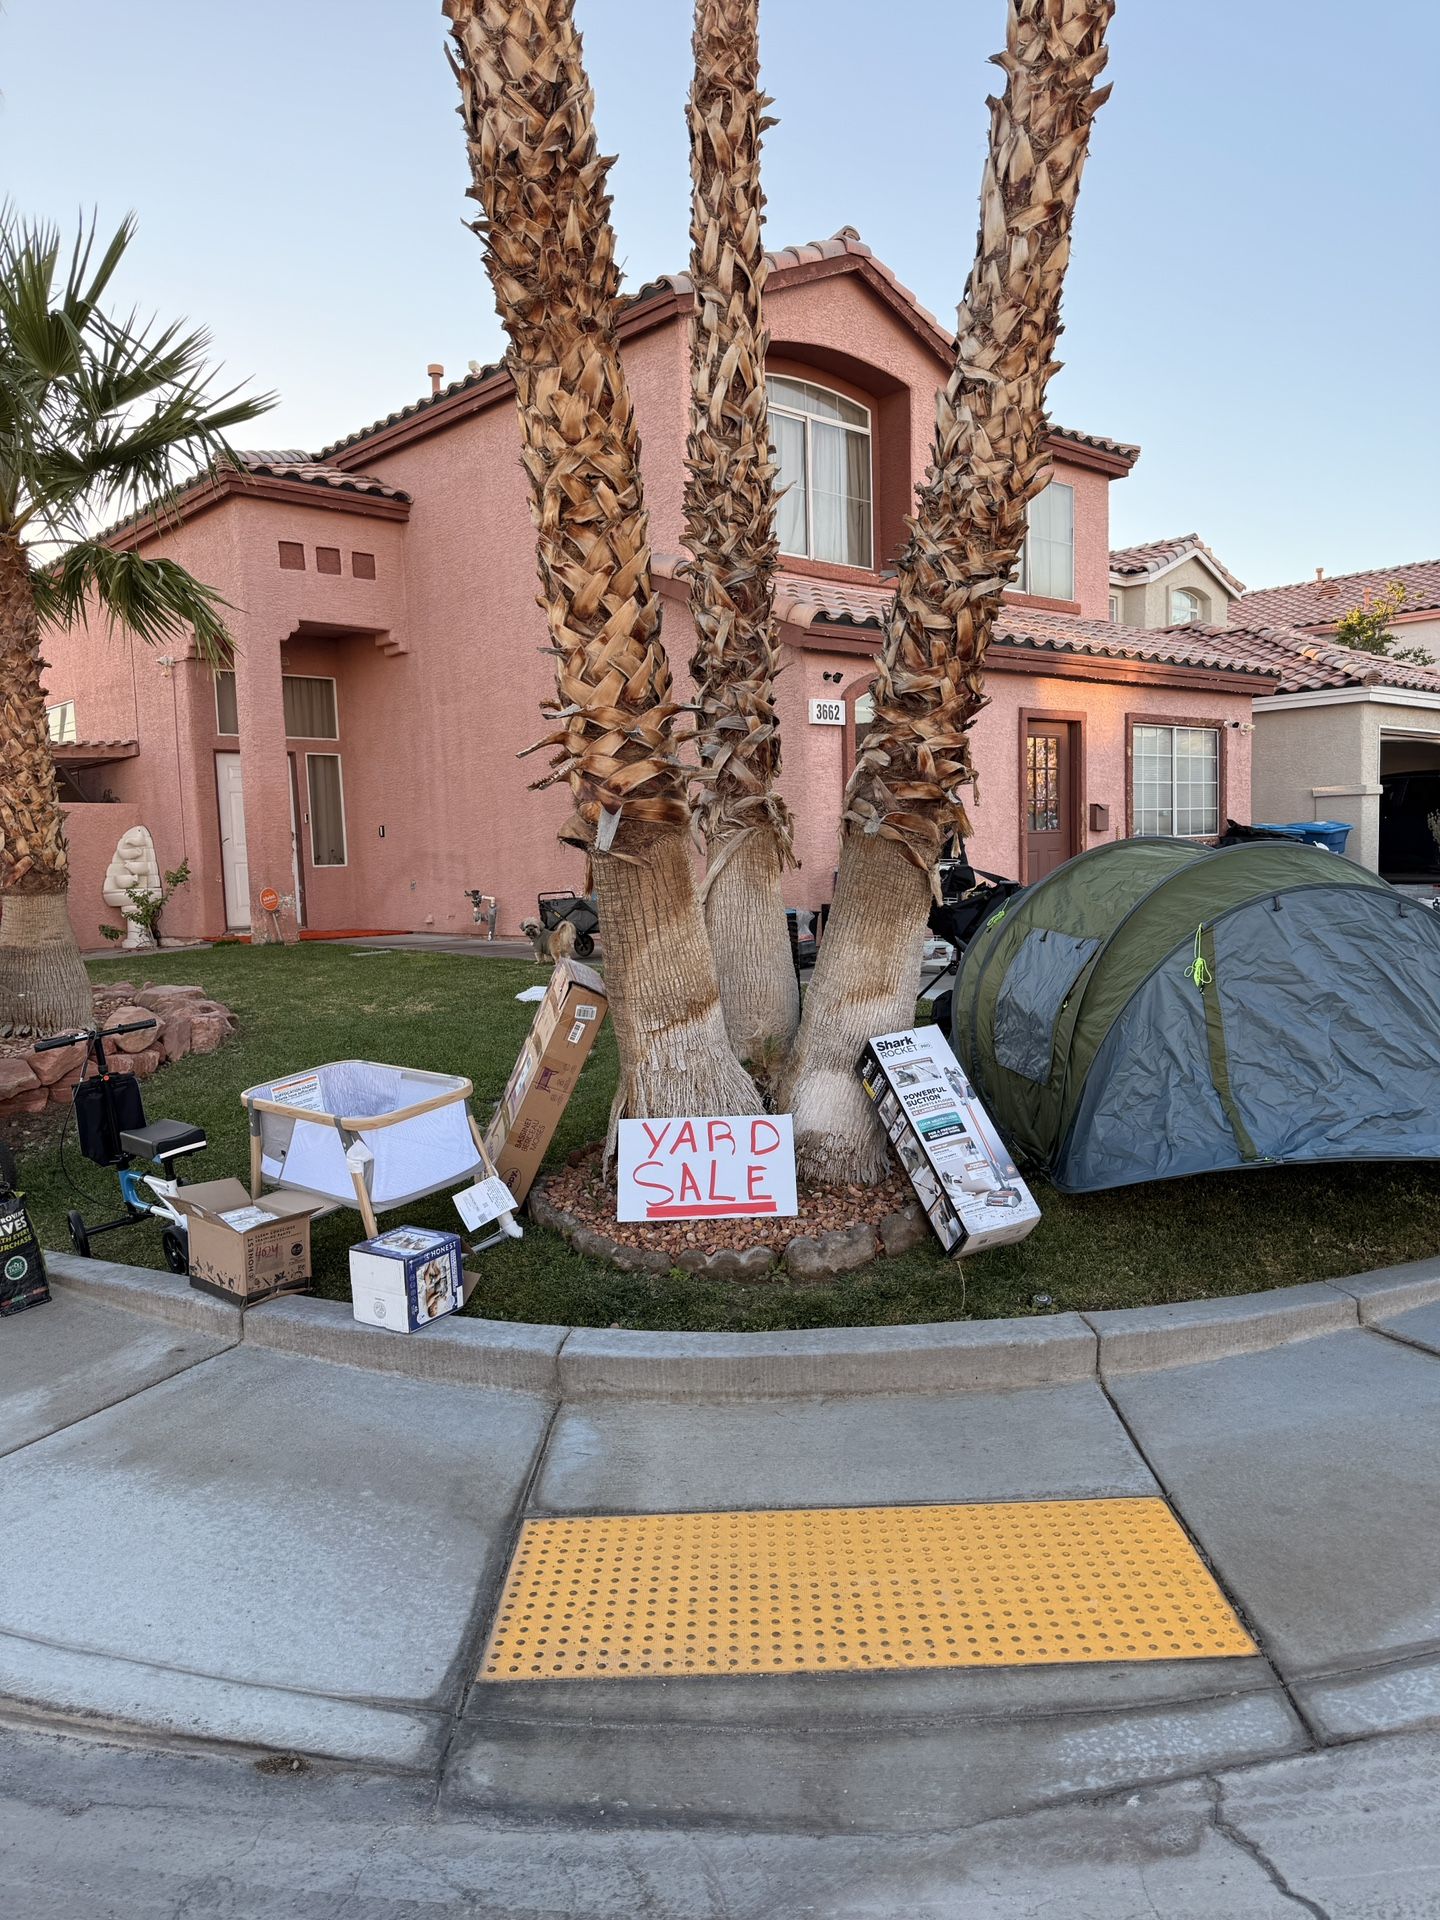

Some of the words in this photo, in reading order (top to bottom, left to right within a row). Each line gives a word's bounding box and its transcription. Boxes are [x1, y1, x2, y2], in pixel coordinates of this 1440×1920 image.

[816, 703, 840, 720] 3662
[876, 1036, 914, 1052] Shark
[880, 1044, 919, 1060] ROCKET
[903, 1086, 947, 1102] POWERFUL
[905, 1093, 941, 1108] SUCTION
[514, 1117, 532, 1149] BASSINET
[521, 1119, 540, 1151] BERCEAU
[641, 1119, 780, 1159] YARD
[633, 1159, 772, 1206] SALE
[430, 1240, 457, 1258] HONEST
